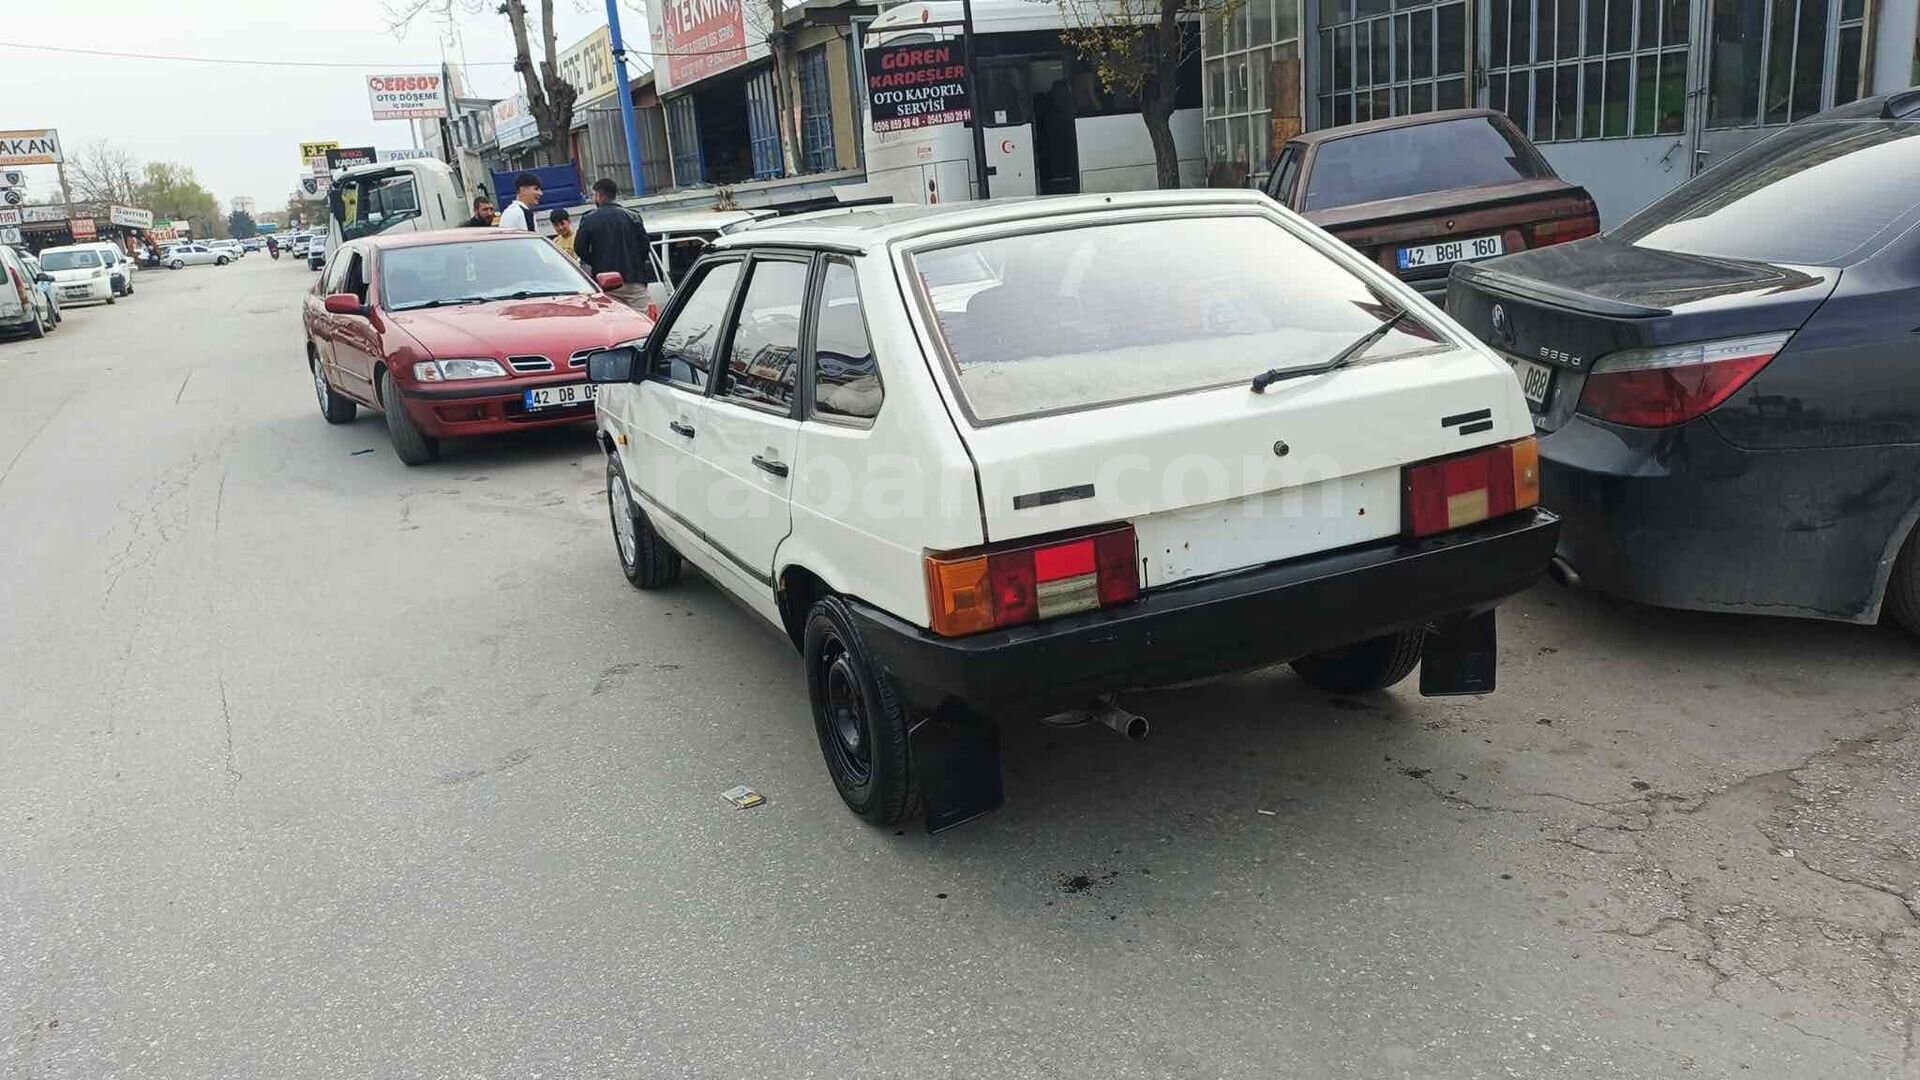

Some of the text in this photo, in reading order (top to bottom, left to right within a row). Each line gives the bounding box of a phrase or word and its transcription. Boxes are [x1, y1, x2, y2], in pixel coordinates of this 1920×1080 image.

[671, 0, 729, 34] TEKN
[881, 47, 950, 70] GÖREN
[384, 76, 440, 92] ERSOY
[870, 65, 966, 88] KARDEŞLER
[376, 91, 439, 102] OTO DÖŞEME
[874, 83, 965, 105] OTO KAPORTA
[896, 97, 946, 116] SERVİSİ
[1408, 238, 1497, 265] 42 BGH 160
[1524, 367, 1547, 398] 088
[534, 390, 550, 405] 42
[558, 387, 575, 402] DB
